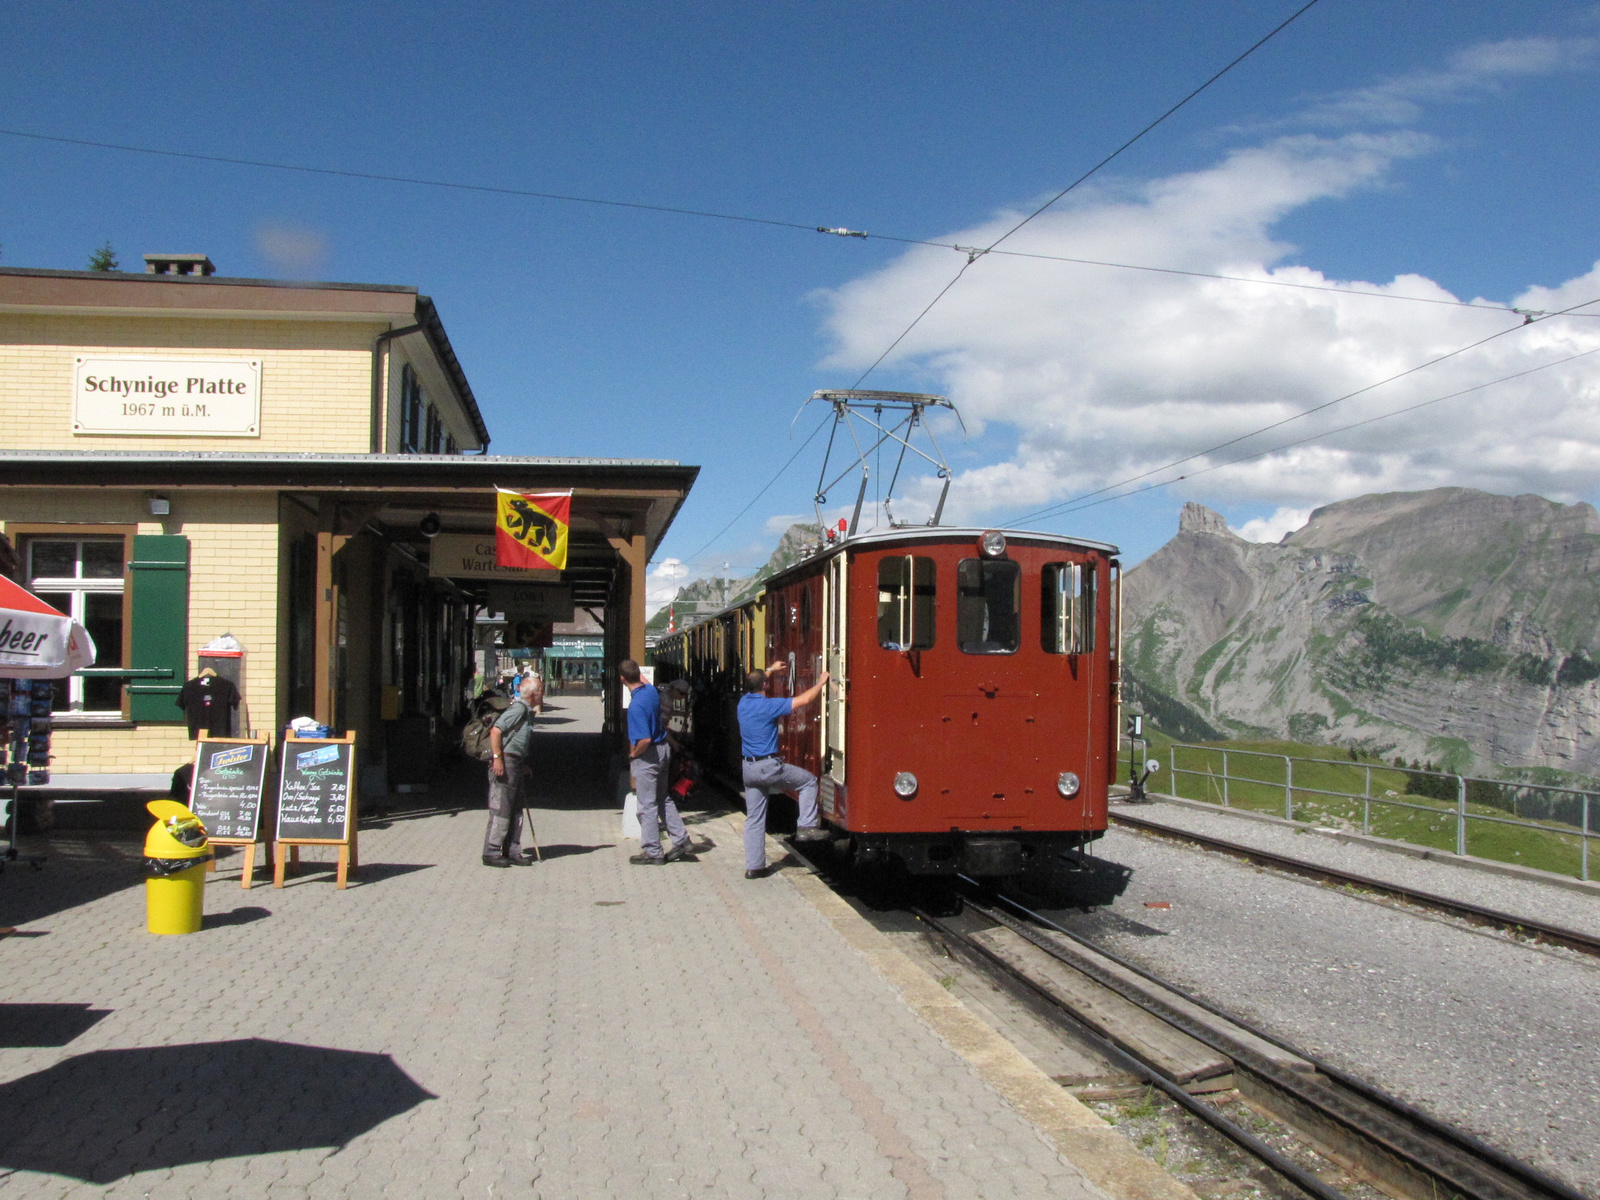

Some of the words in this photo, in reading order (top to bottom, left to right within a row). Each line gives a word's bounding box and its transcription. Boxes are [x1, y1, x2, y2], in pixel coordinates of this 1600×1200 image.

[85, 375, 179, 398] Schynige
[186, 377, 247, 395] Platte
[121, 403, 156, 416] 1967
[162, 405, 175, 416] m
[181, 403, 211, 417] ü.M.
[0, 619, 48, 651] beer
[327, 813, 345, 824] 6,50
